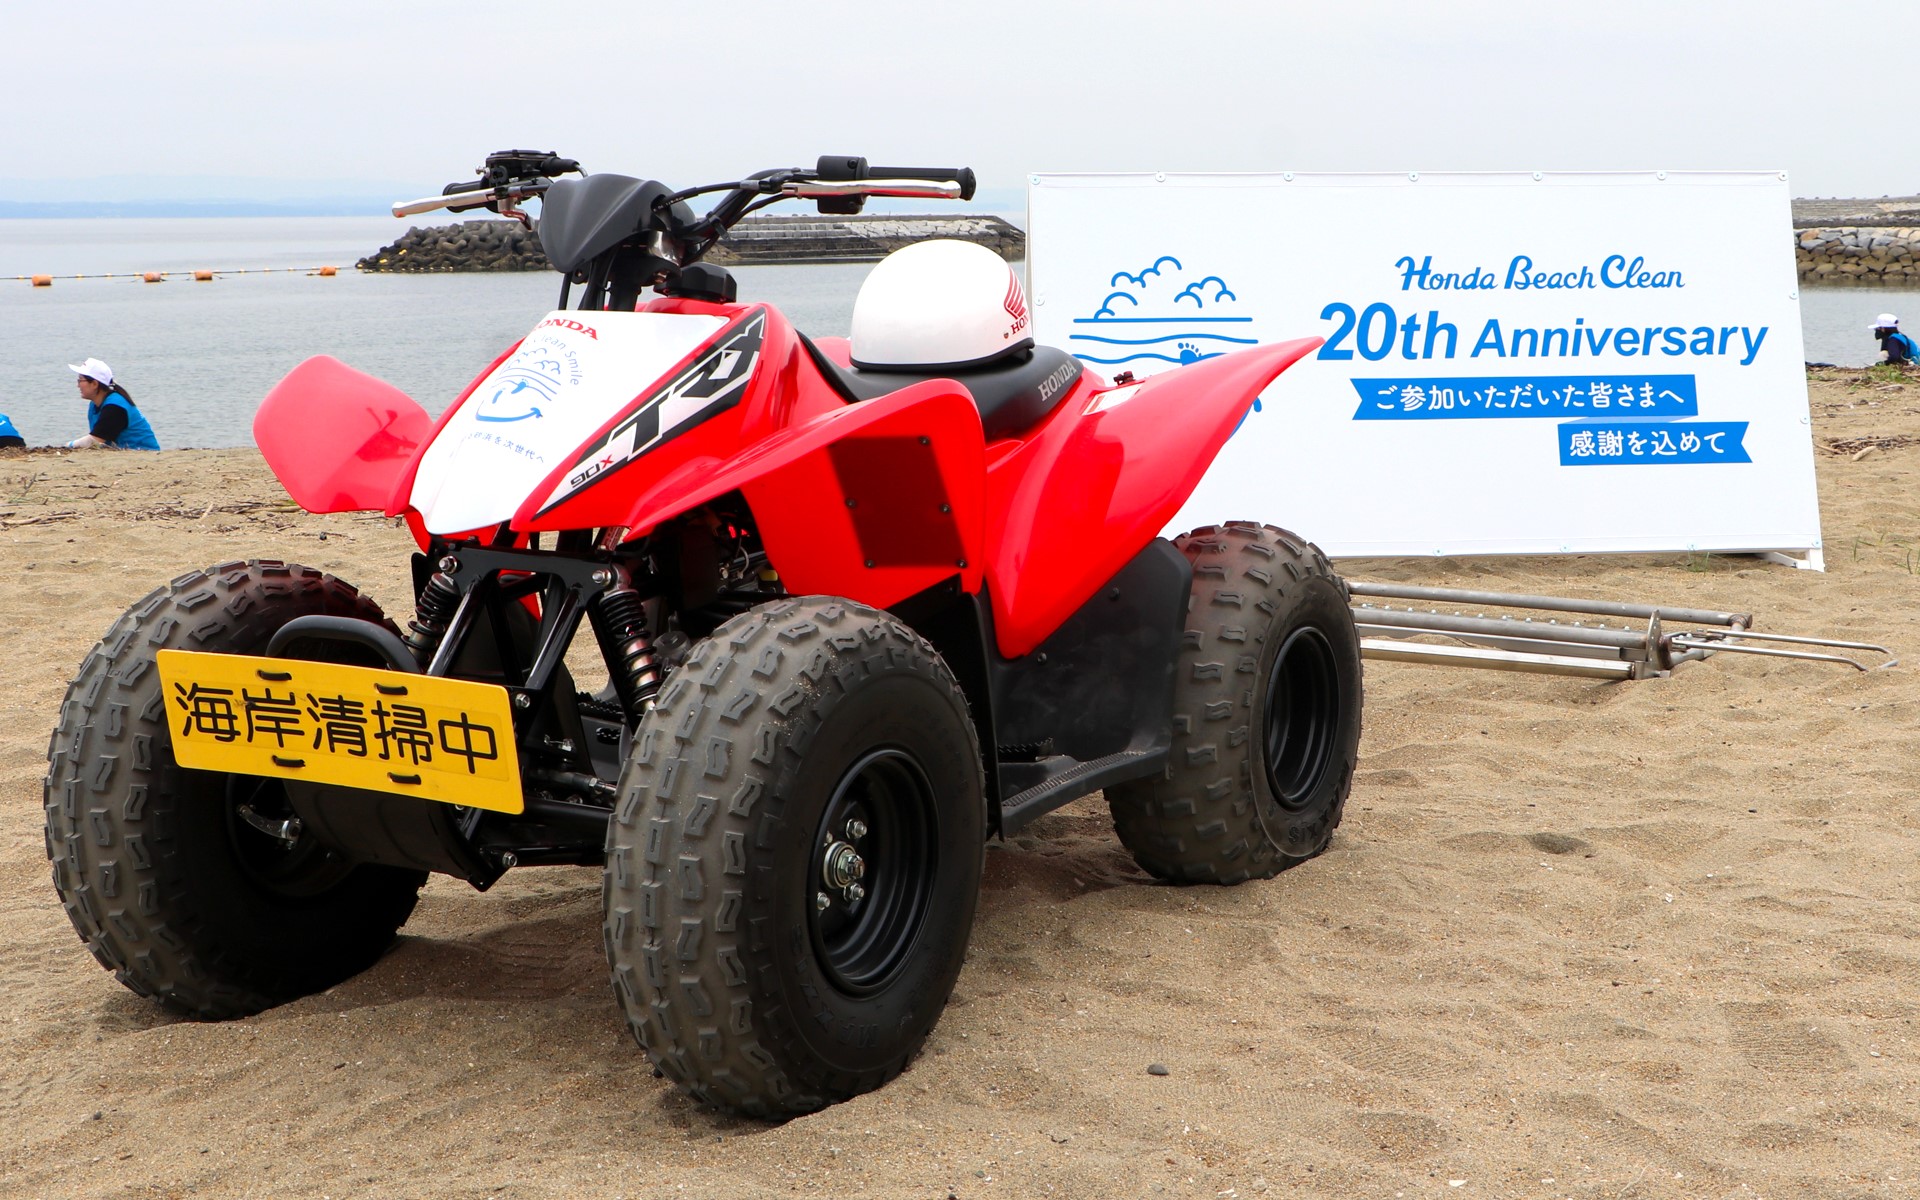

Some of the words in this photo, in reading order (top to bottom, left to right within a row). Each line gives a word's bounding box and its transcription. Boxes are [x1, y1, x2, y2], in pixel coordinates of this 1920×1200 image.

[1394, 255, 1497, 291] Honda
[1503, 254, 1596, 291] Beach
[1600, 253, 1684, 289] Clean
[531, 318, 599, 341] ONDA
[1316, 301, 1459, 362] 20th
[1470, 317, 1770, 367] Anniversary
[564, 350, 583, 386] Smile
[1037, 360, 1077, 402] HONDA
[1376, 381, 1685, 412] ご参加いただいた皆さまへ
[1568, 430, 1727, 457] 感謝を込めて
[173, 681, 499, 775] 海岸清掃中
